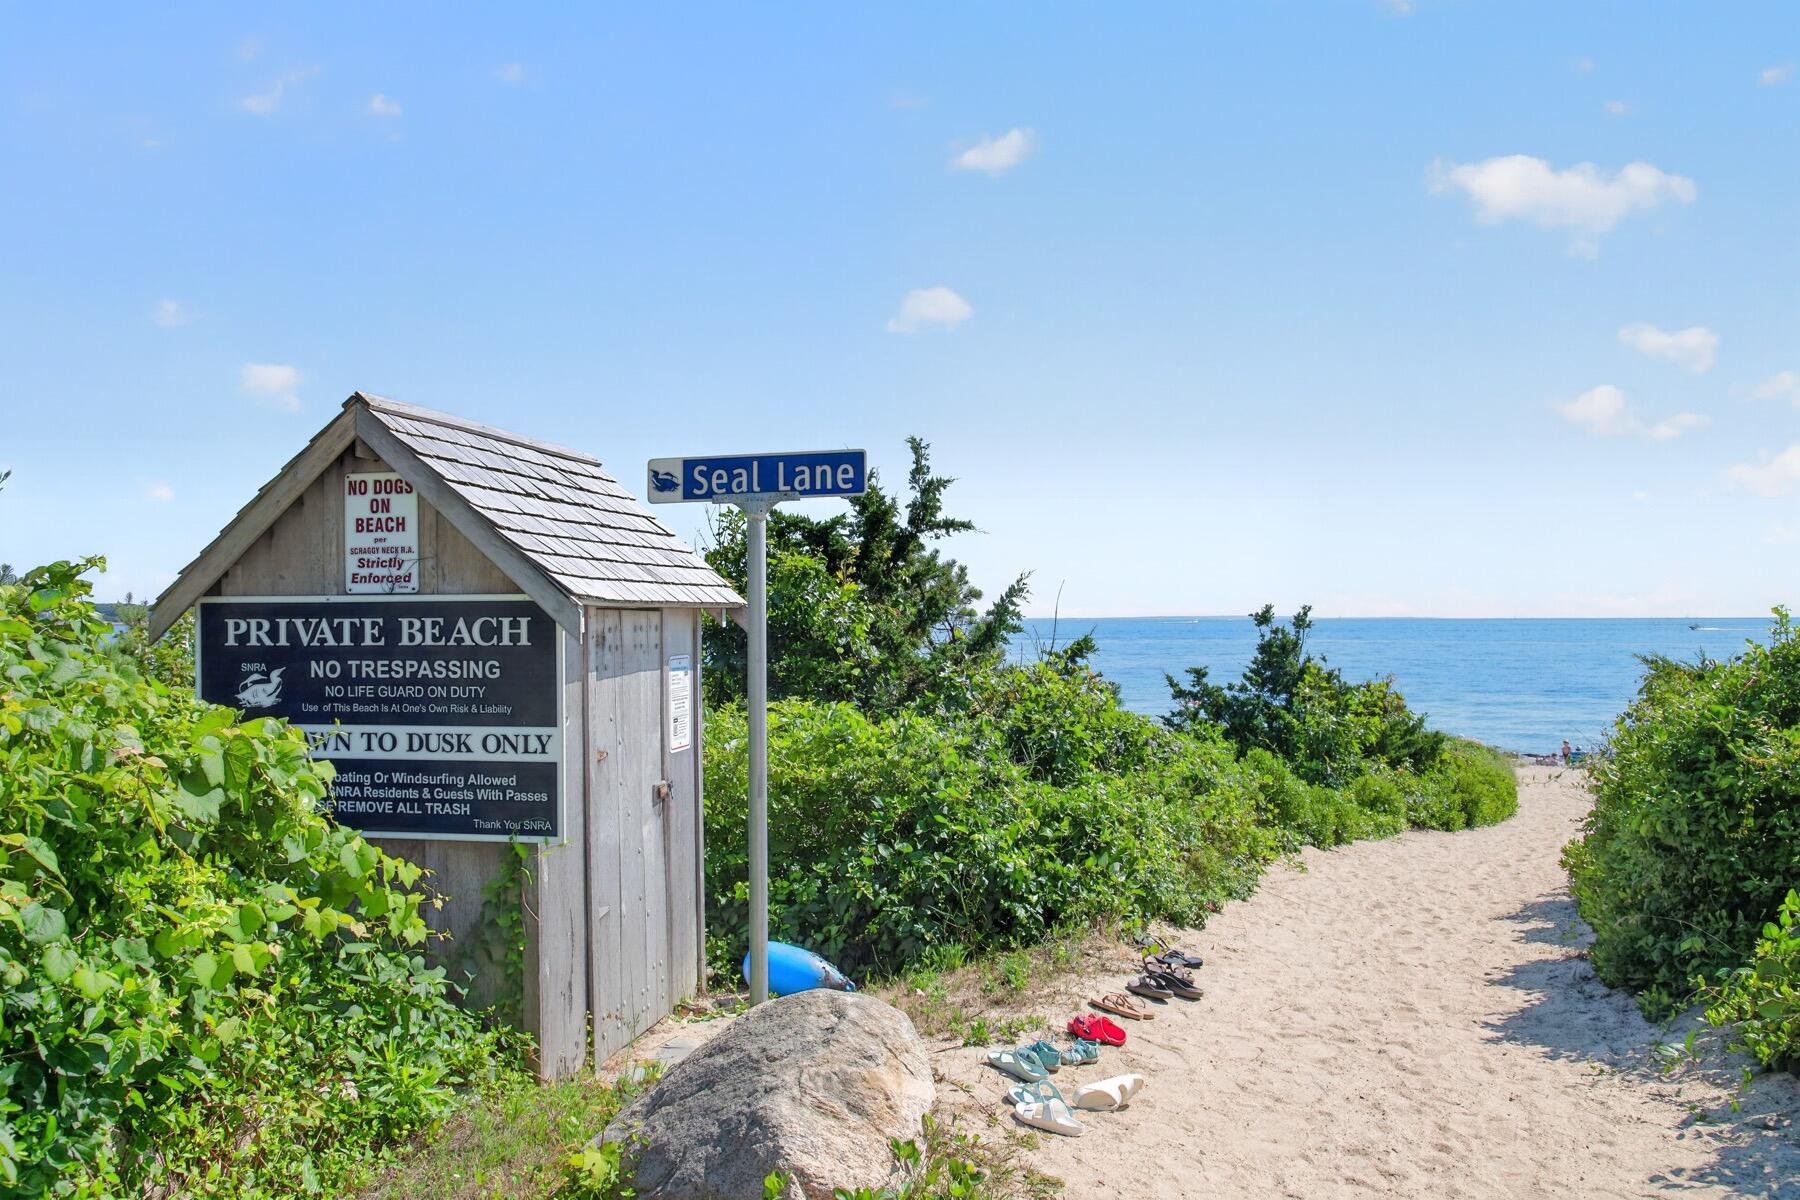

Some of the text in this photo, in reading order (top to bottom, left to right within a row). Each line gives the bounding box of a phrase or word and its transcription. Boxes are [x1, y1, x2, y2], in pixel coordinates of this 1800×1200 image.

[693, 460, 854, 495] Seal Lane
[348, 479, 413, 495] NO DOGS
[370, 499, 390, 514] ON
[355, 517, 406, 533] BEACH
[350, 547, 379, 555] SCRAGGY
[357, 557, 404, 570] Strictly
[351, 572, 412, 584] Enforced
[224, 617, 532, 647] PRIVATE BEACH
[240, 663, 267, 673] SNRA
[310, 659, 501, 680] NO TRESPASSING
[325, 686, 486, 698] NO LIFE GUARD ON DUTY
[302, 703, 512, 715] Use of This Beach Is At One's Own Risk & Liability
[360, 731, 398, 753] TO
[406, 733, 472, 754] DUSK
[481, 733, 553, 755] ONLY
[334, 772, 517, 788] oating Or Windsurfing Allowed
[363, 787, 420, 799] Residents
[422, 788, 431, 799] &
[433, 787, 474, 801] Guests
[476, 789, 502, 801] With
[505, 790, 548, 802] Passes
[338, 801, 394, 814] REMOVE
[396, 802, 422, 815] ALL
[425, 802, 471, 815] TRASH
[473, 819, 552, 831] Thank You SNRA
